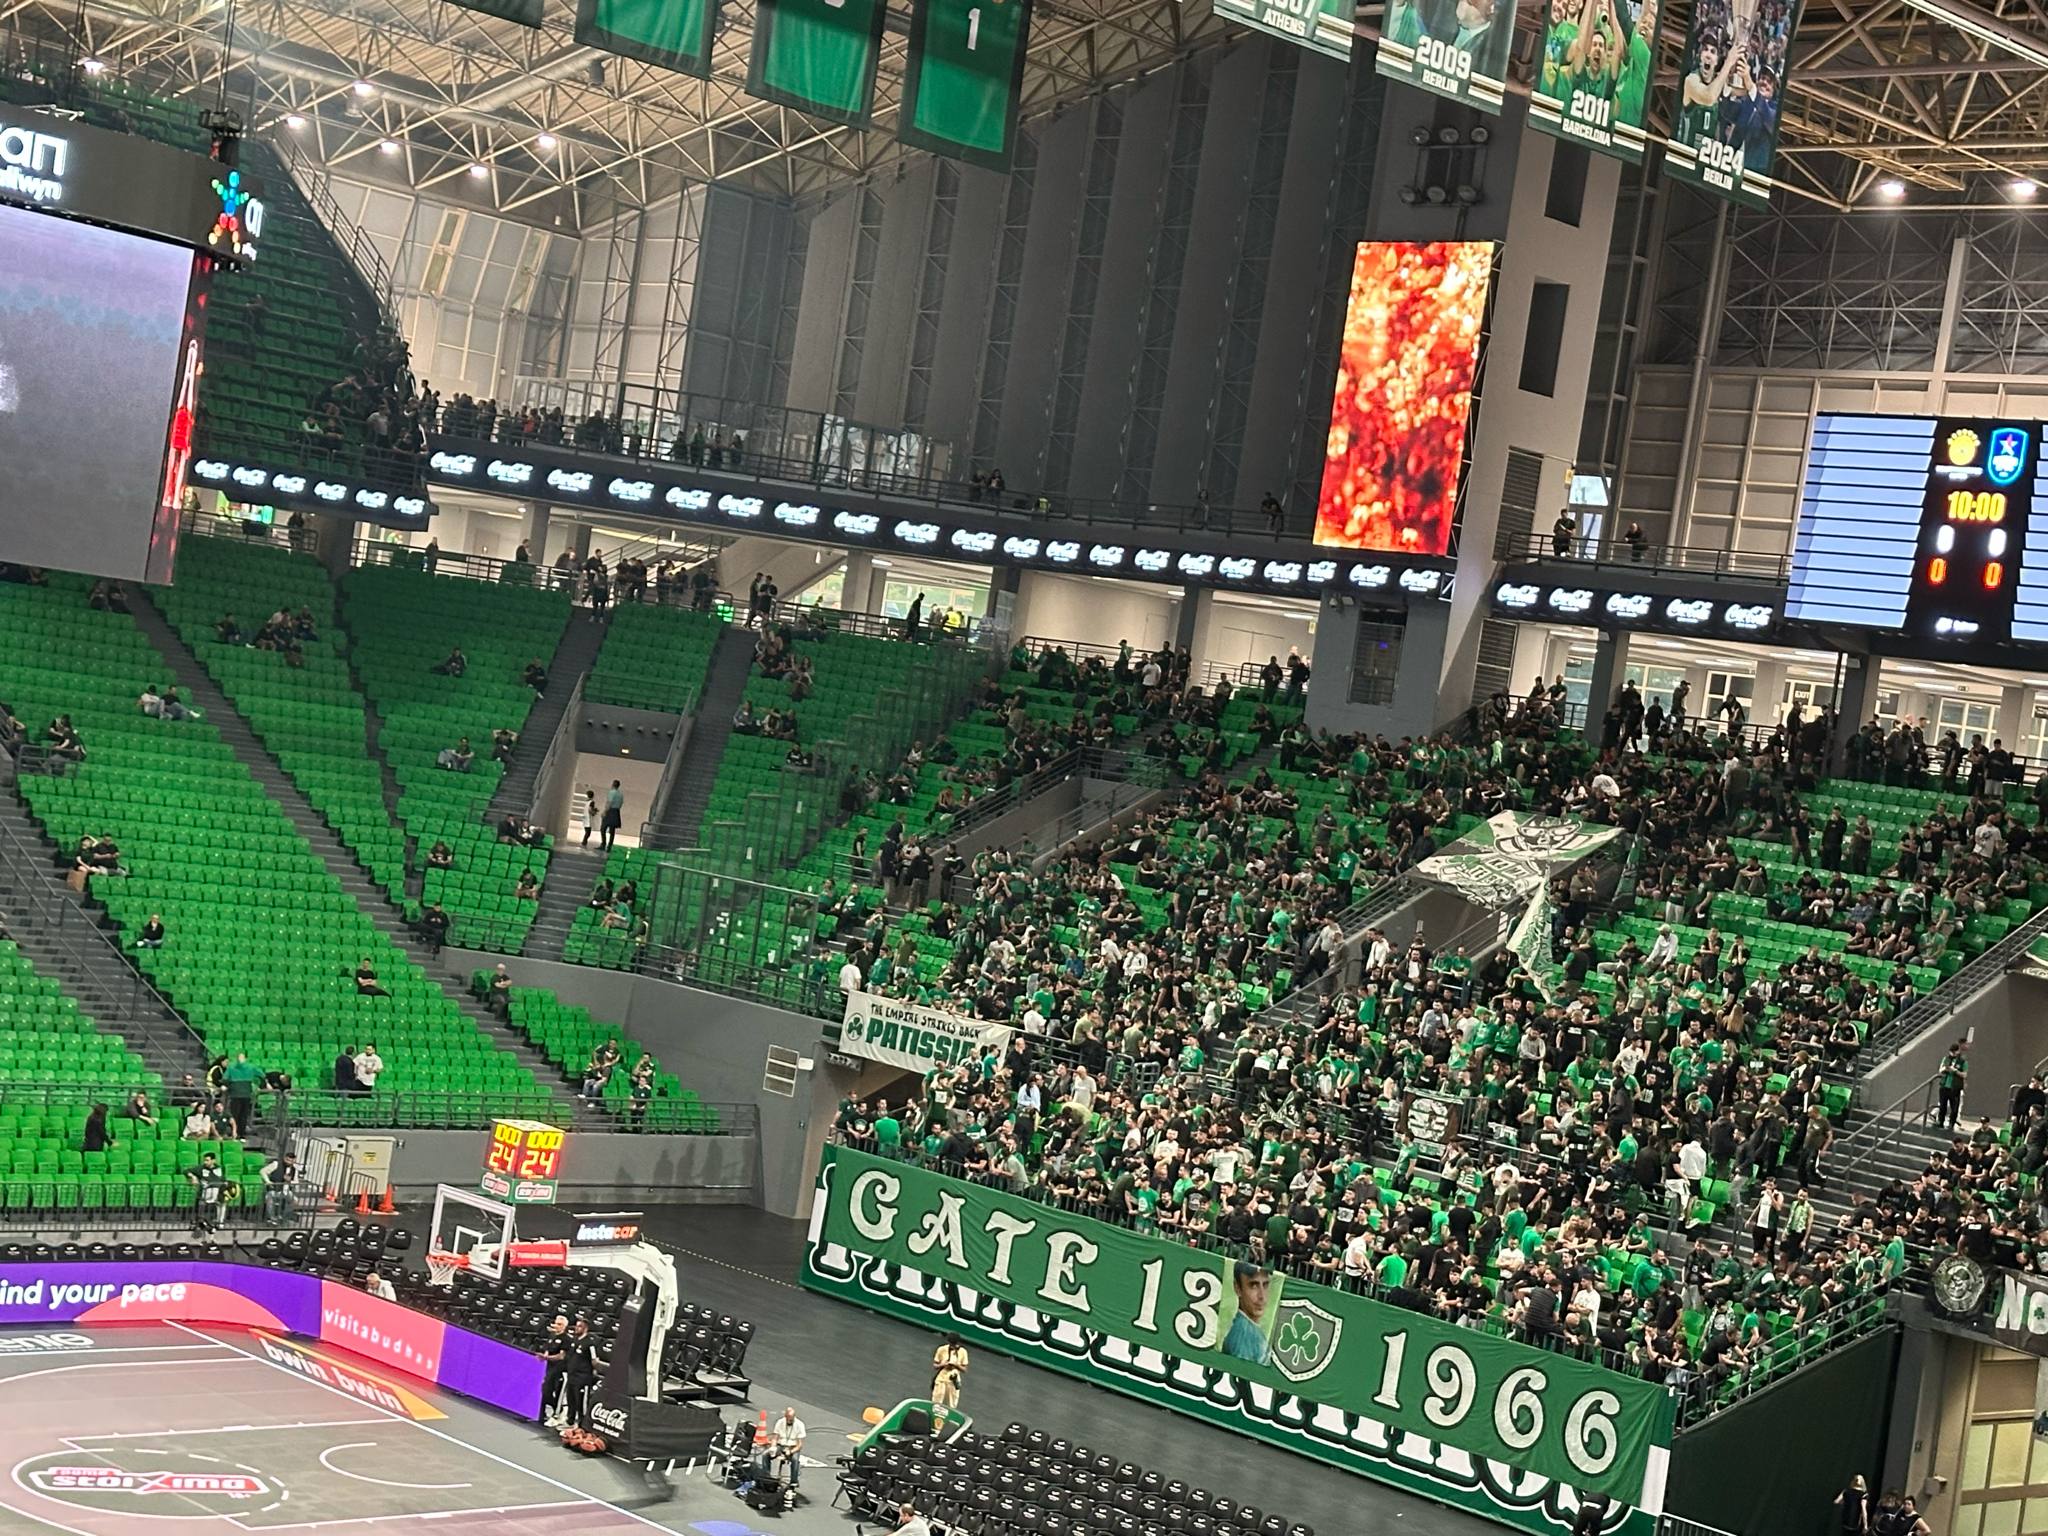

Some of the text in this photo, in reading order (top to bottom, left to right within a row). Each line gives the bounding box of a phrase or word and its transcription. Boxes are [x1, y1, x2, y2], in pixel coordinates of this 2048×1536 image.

[967, 7, 981, 51] 1
[1262, 8, 1306, 37] ATHENS
[1414, 35, 1472, 80] 2009
[1421, 68, 1459, 94] BERLIN
[1570, 89, 1610, 127] 2011
[1561, 118, 1611, 147] BARCELONA
[1698, 136, 1744, 176] 2024
[1702, 167, 1734, 191] BERLIN
[1947, 490, 2006, 522] 10:00
[1929, 558, 2002, 588] 0 0
[871, 1003, 981, 1039] THE EMPIRE STRIKES BACK
[488, 1141, 515, 1171] 24
[520, 1150, 555, 1175] 24
[577, 1223, 638, 1241] instacar
[849, 1169, 1224, 1349] GATE 13
[49, 1284, 115, 1310] your
[120, 1284, 187, 1309] pace
[591, 1402, 629, 1431] Coca-Cola
[1372, 1329, 1622, 1475] 1966
